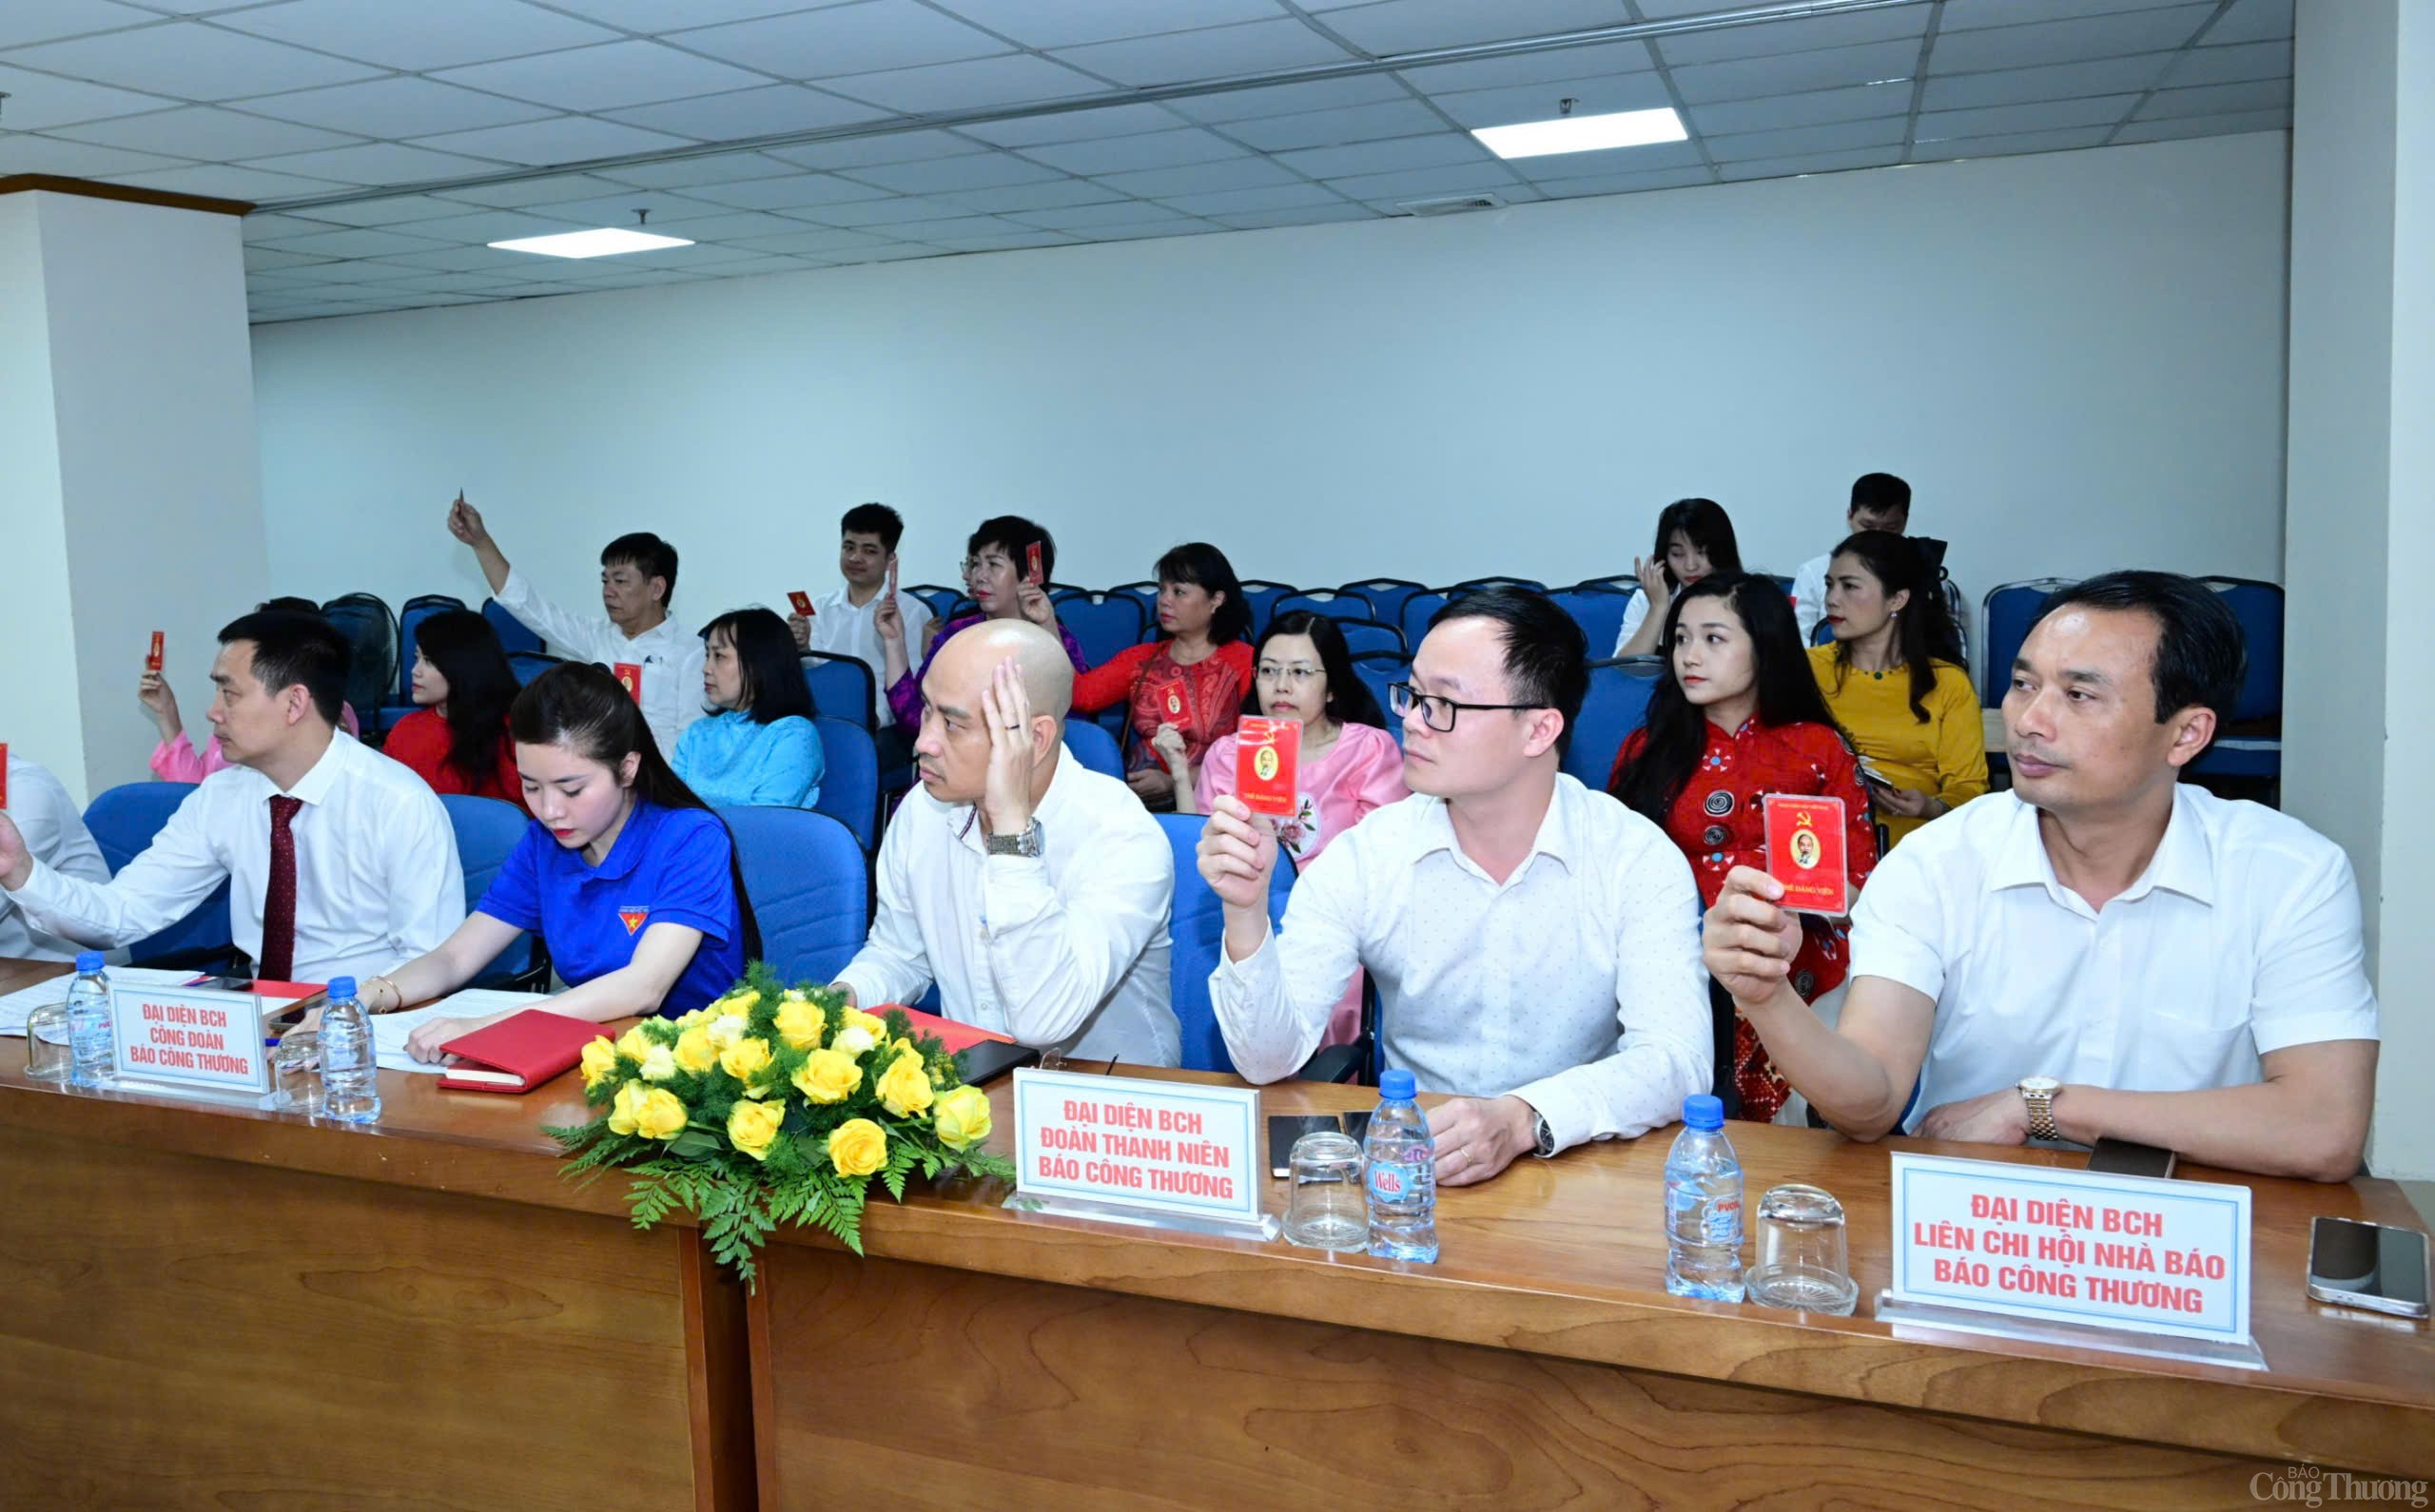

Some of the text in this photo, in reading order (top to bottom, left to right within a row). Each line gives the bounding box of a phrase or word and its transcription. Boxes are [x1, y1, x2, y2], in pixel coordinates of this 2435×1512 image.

[143, 1003, 226, 1027] ĐẠI DIỆN BCH
[150, 1025, 224, 1051] CÔNG ĐOÀN
[129, 1043, 248, 1075] BÁO CÔNG THƯƠNG
[1063, 1099, 1202, 1134] ĐẠI DIỆN BCH
[1040, 1125, 1230, 1169] ĐOÀN THANH NIÊN
[1039, 1153, 1234, 1199] BÁO CÔNG THƯƠNG
[1373, 1171, 1401, 1192] Wells
[1971, 1193, 2163, 1238] ĐẠI DIỆN BCH
[1914, 1219, 2226, 1281] LIÊN CHI HỘI NHÀ BÁO
[1934, 1255, 2204, 1314] BÁO CÔNG THƯƠNG
